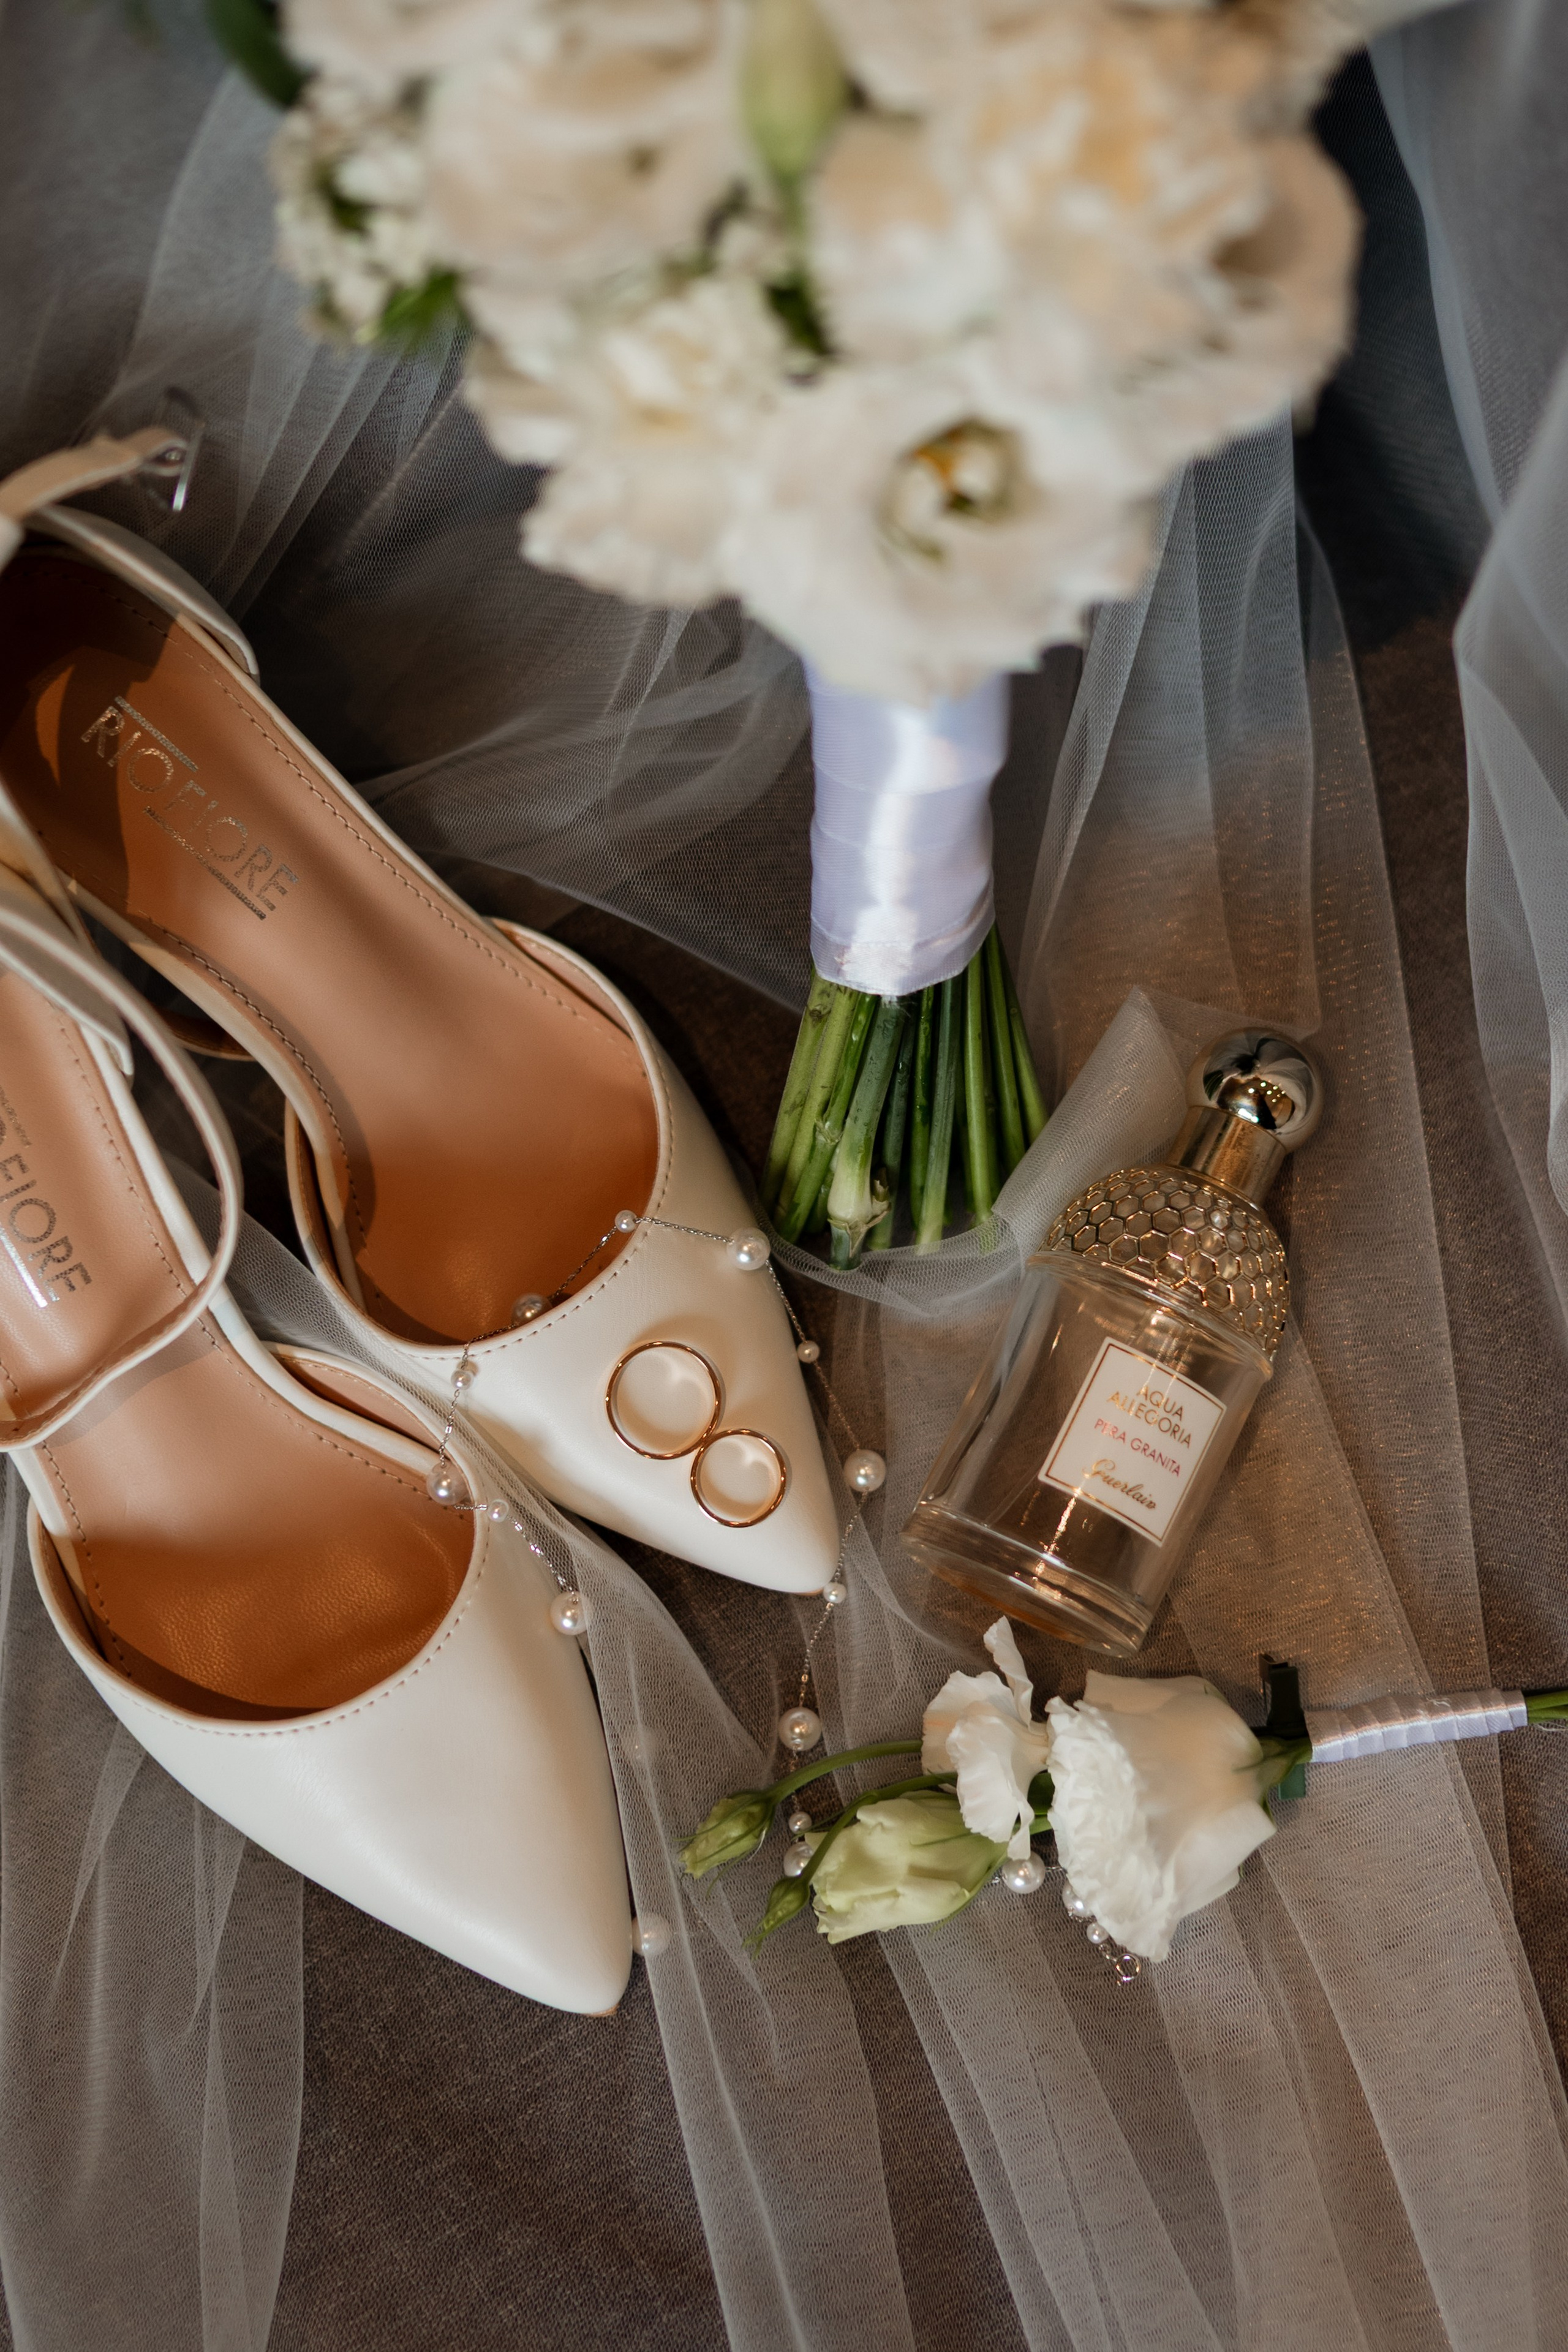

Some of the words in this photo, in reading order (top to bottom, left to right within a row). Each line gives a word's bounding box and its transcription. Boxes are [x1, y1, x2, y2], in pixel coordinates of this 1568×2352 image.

[1107, 1391, 1192, 1449] ALLEGORIA
[1137, 1386, 1183, 1421] AQUA
[1095, 1419, 1126, 1444] PERA
[1131, 1438, 1182, 1477] GRANITA
[1083, 1459, 1156, 1510] Guerlain
